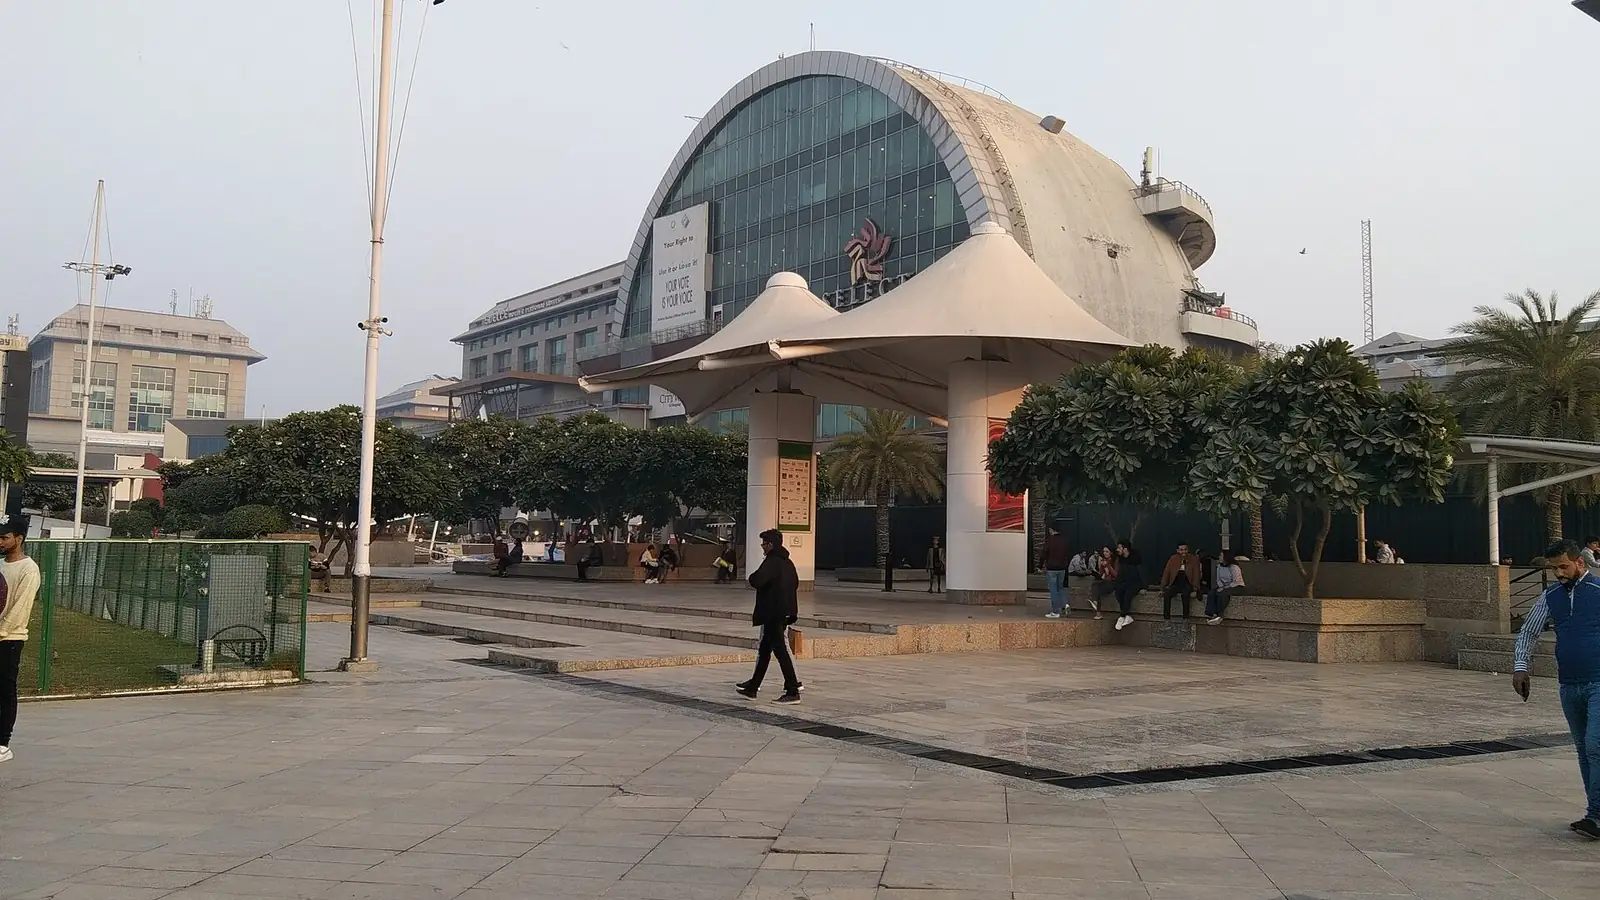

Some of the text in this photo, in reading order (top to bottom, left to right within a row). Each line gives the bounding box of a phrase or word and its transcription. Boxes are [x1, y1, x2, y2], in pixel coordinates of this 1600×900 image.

[676, 236, 688, 246] Right
[665, 275, 690, 292] YOUR VOTE
[666, 293, 678, 308] YOUR
[679, 290, 692, 305] VOICE
